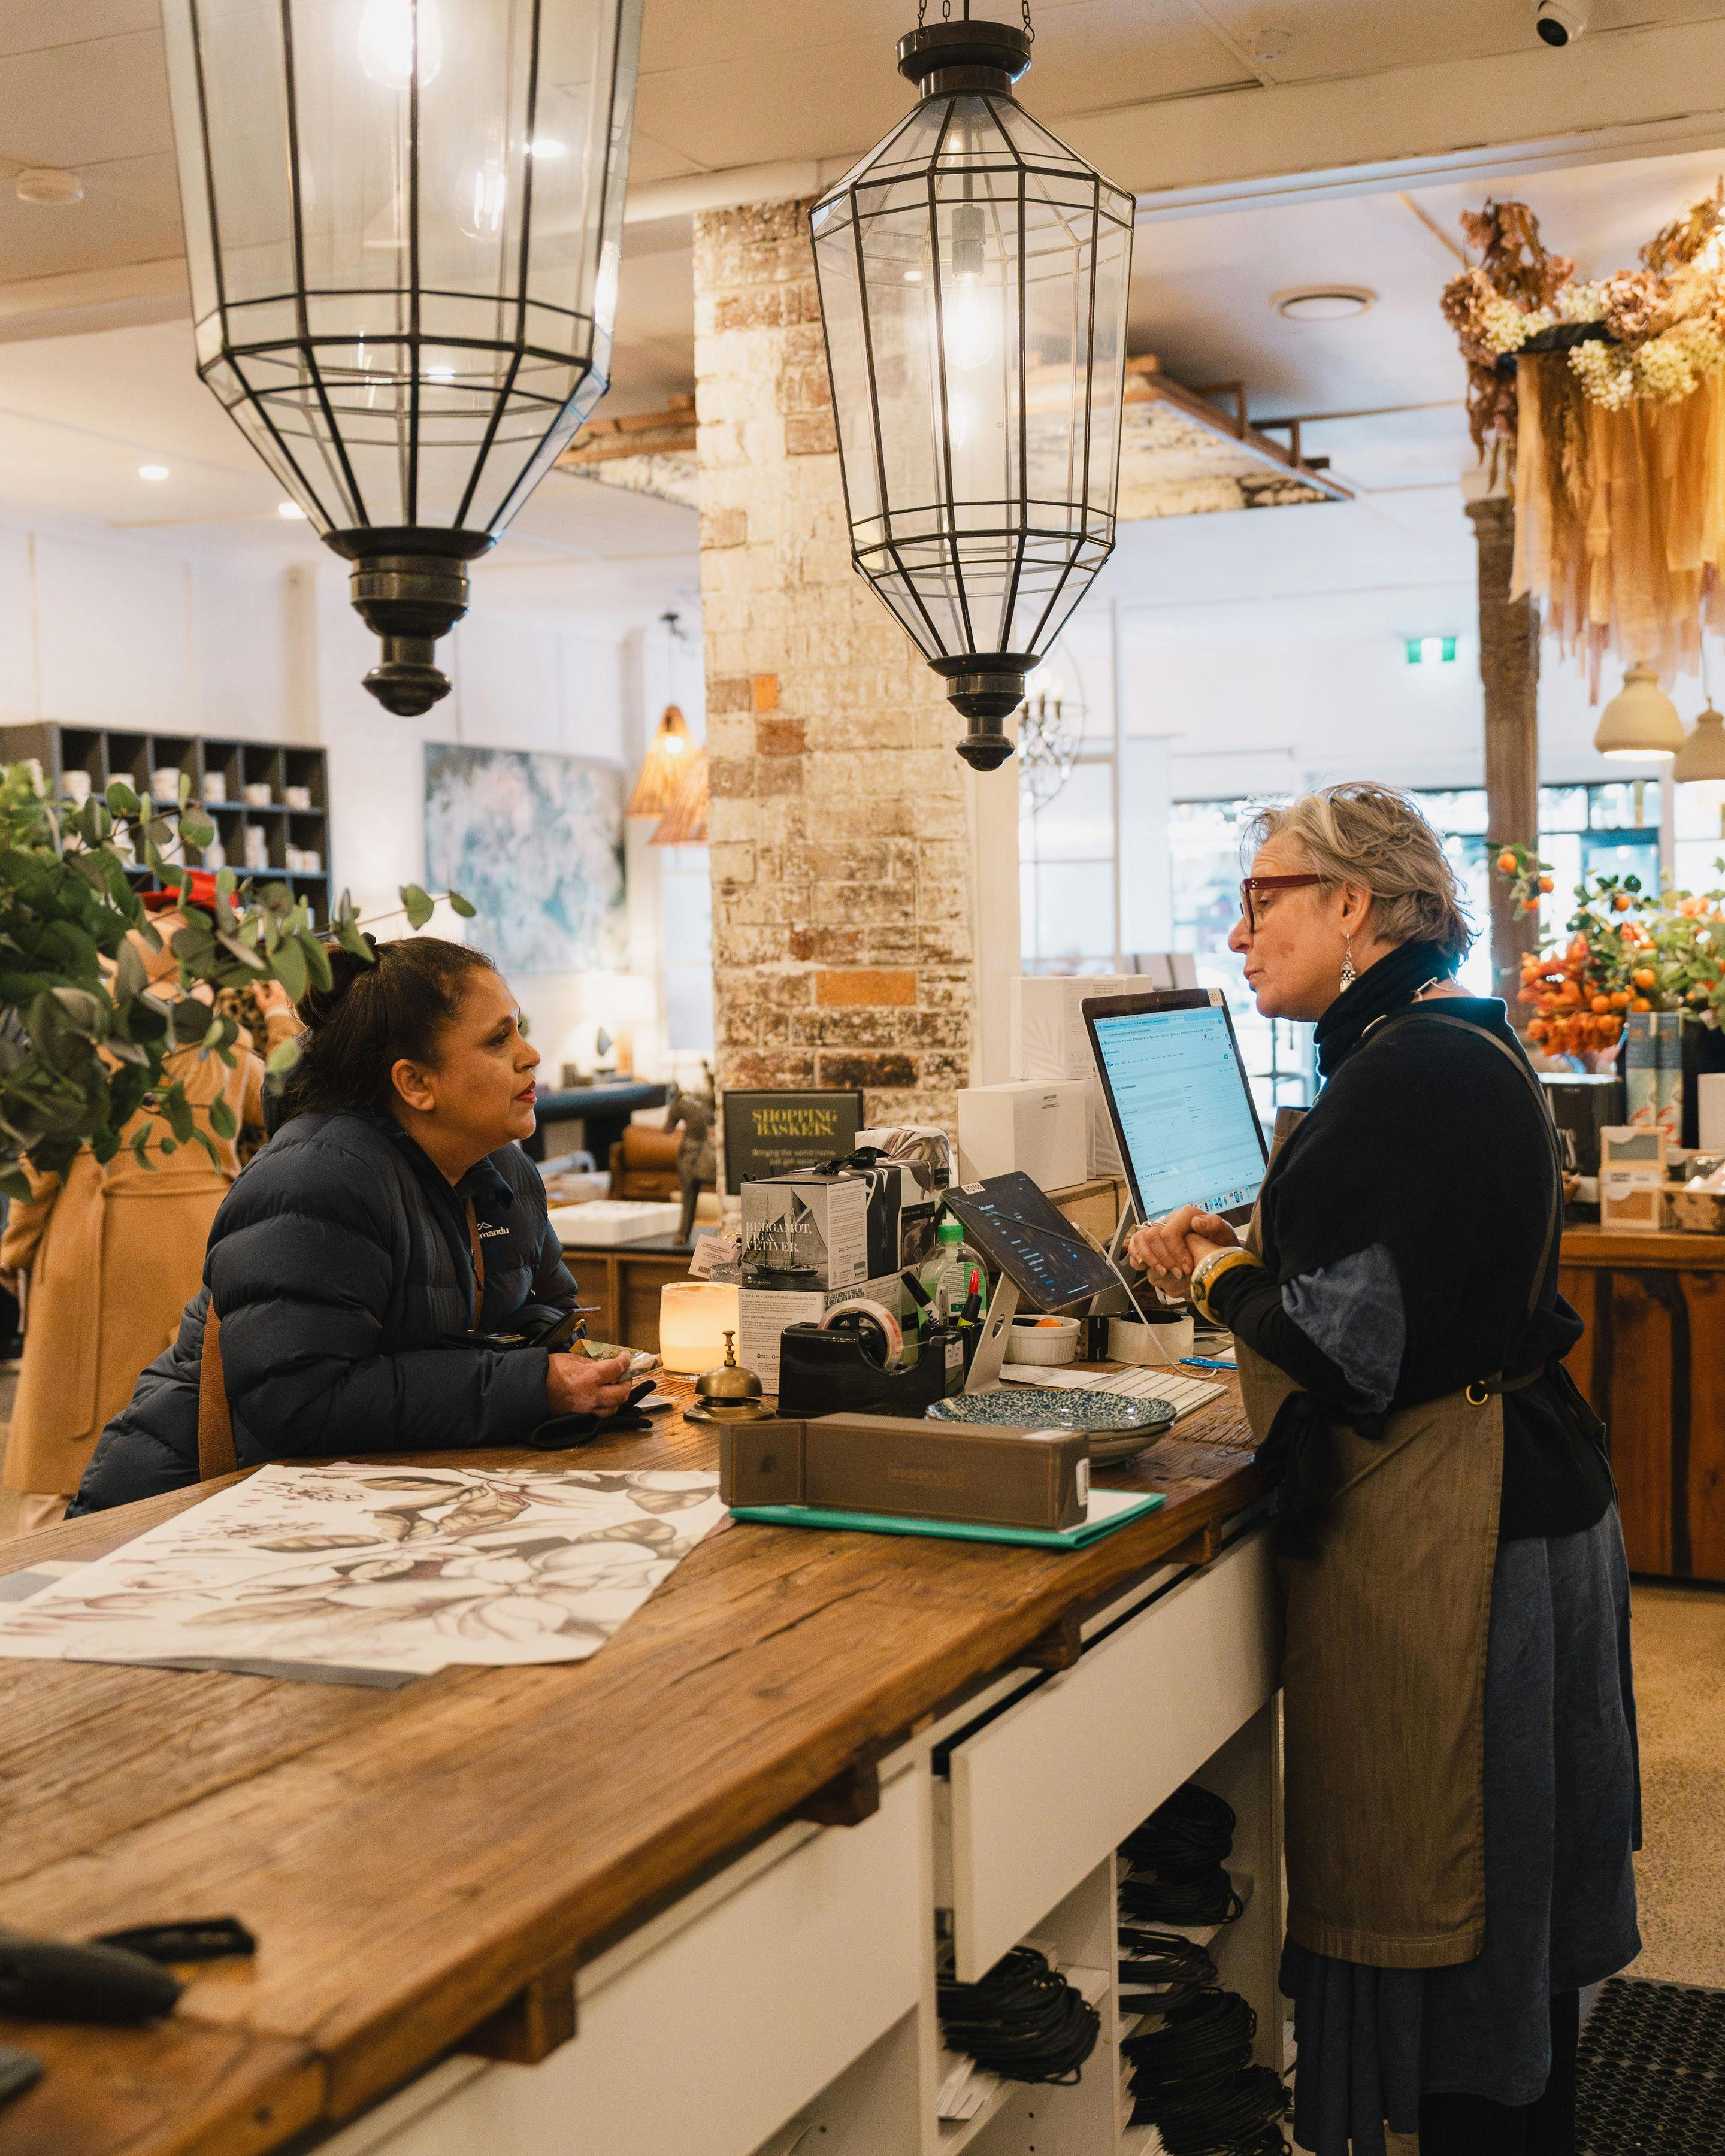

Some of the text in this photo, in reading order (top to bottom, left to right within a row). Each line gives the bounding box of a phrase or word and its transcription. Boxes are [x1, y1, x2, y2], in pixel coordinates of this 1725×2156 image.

[752, 1109, 839, 1123] SHOPPING
[479, 1226, 509, 1239] mandu
[746, 1222, 812, 1234] BERGAMOT,
[746, 1231, 775, 1242] FIG &
[745, 1241, 800, 1252] VETIVER.
